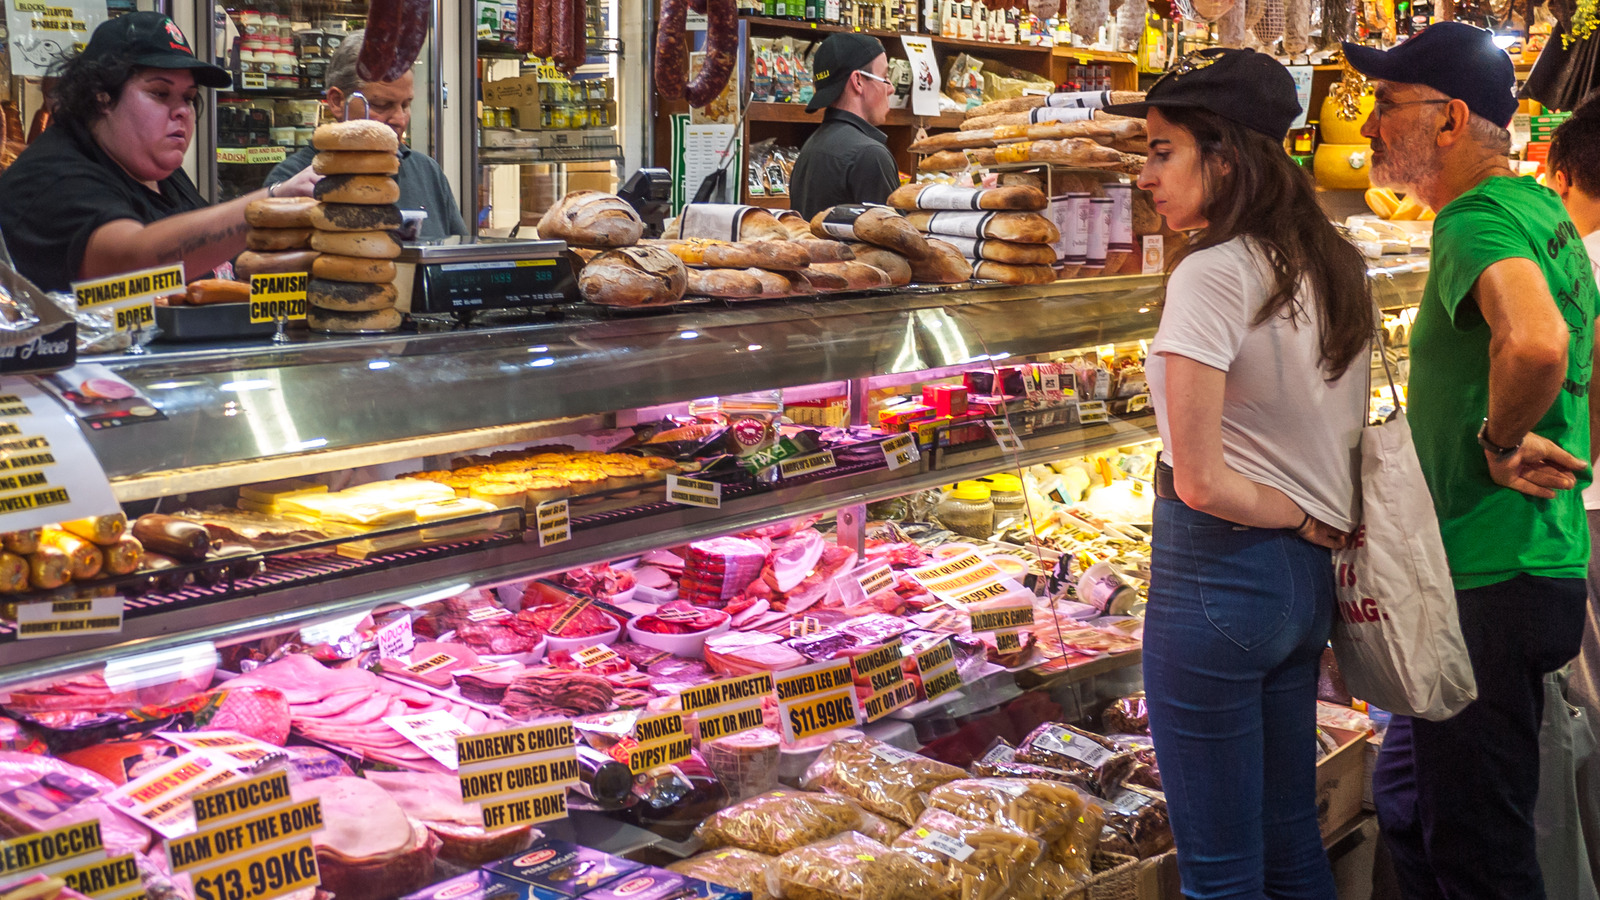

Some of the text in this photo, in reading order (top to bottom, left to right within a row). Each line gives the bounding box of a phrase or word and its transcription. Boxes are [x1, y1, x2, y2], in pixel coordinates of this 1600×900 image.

[43, 8, 73, 17] TLANTIC
[76, 270, 183, 306] SPINACH AND FETTA
[251, 275, 307, 295] SPANISH
[117, 305, 153, 328] BOREK
[251, 299, 306, 319] CHORIZO
[11, 453, 55, 468] AWARD
[782, 458, 811, 472] ANDREW'S
[18, 472, 47, 487] HAM
[940, 555, 982, 575] QUALITY!!
[965, 564, 998, 583] BACON
[1340, 562, 1357, 588] IS
[987, 582, 1007, 597] KG
[971, 610, 1010, 629] ANDREW'S
[1010, 608, 1034, 625] CHOICE
[996, 633, 1020, 650] BACON
[408, 661, 431, 673] CORN
[856, 644, 903, 675] HUNGARIAN
[918, 644, 953, 672] CHORIZO
[776, 667, 853, 700] SHAVED LEG HAM
[871, 665, 904, 691] SALAMI
[925, 669, 961, 698] SAUSAGE
[680, 675, 772, 711] ITALIAN PANCETTA
[865, 682, 916, 718] HOT OR MILD
[636, 715, 682, 742] SMOKED
[699, 708, 763, 739] HOT OR MILD
[789, 696, 855, 737] $11.99KG
[458, 732, 526, 762] ANDREW'S
[527, 725, 575, 750] CHOICE
[631, 738, 692, 771] GYPSY HAM
[131, 775, 181, 803] THEO'S
[175, 762, 206, 783] DELI
[460, 759, 579, 798] HONEY CURED HAM
[193, 775, 290, 822] BERTOCCHI
[482, 793, 566, 828] OFF THE BONE
[170, 802, 323, 868] HAM OFF THE BONE
[64, 858, 139, 895] CARVED
[194, 846, 316, 900] $13.99KG
